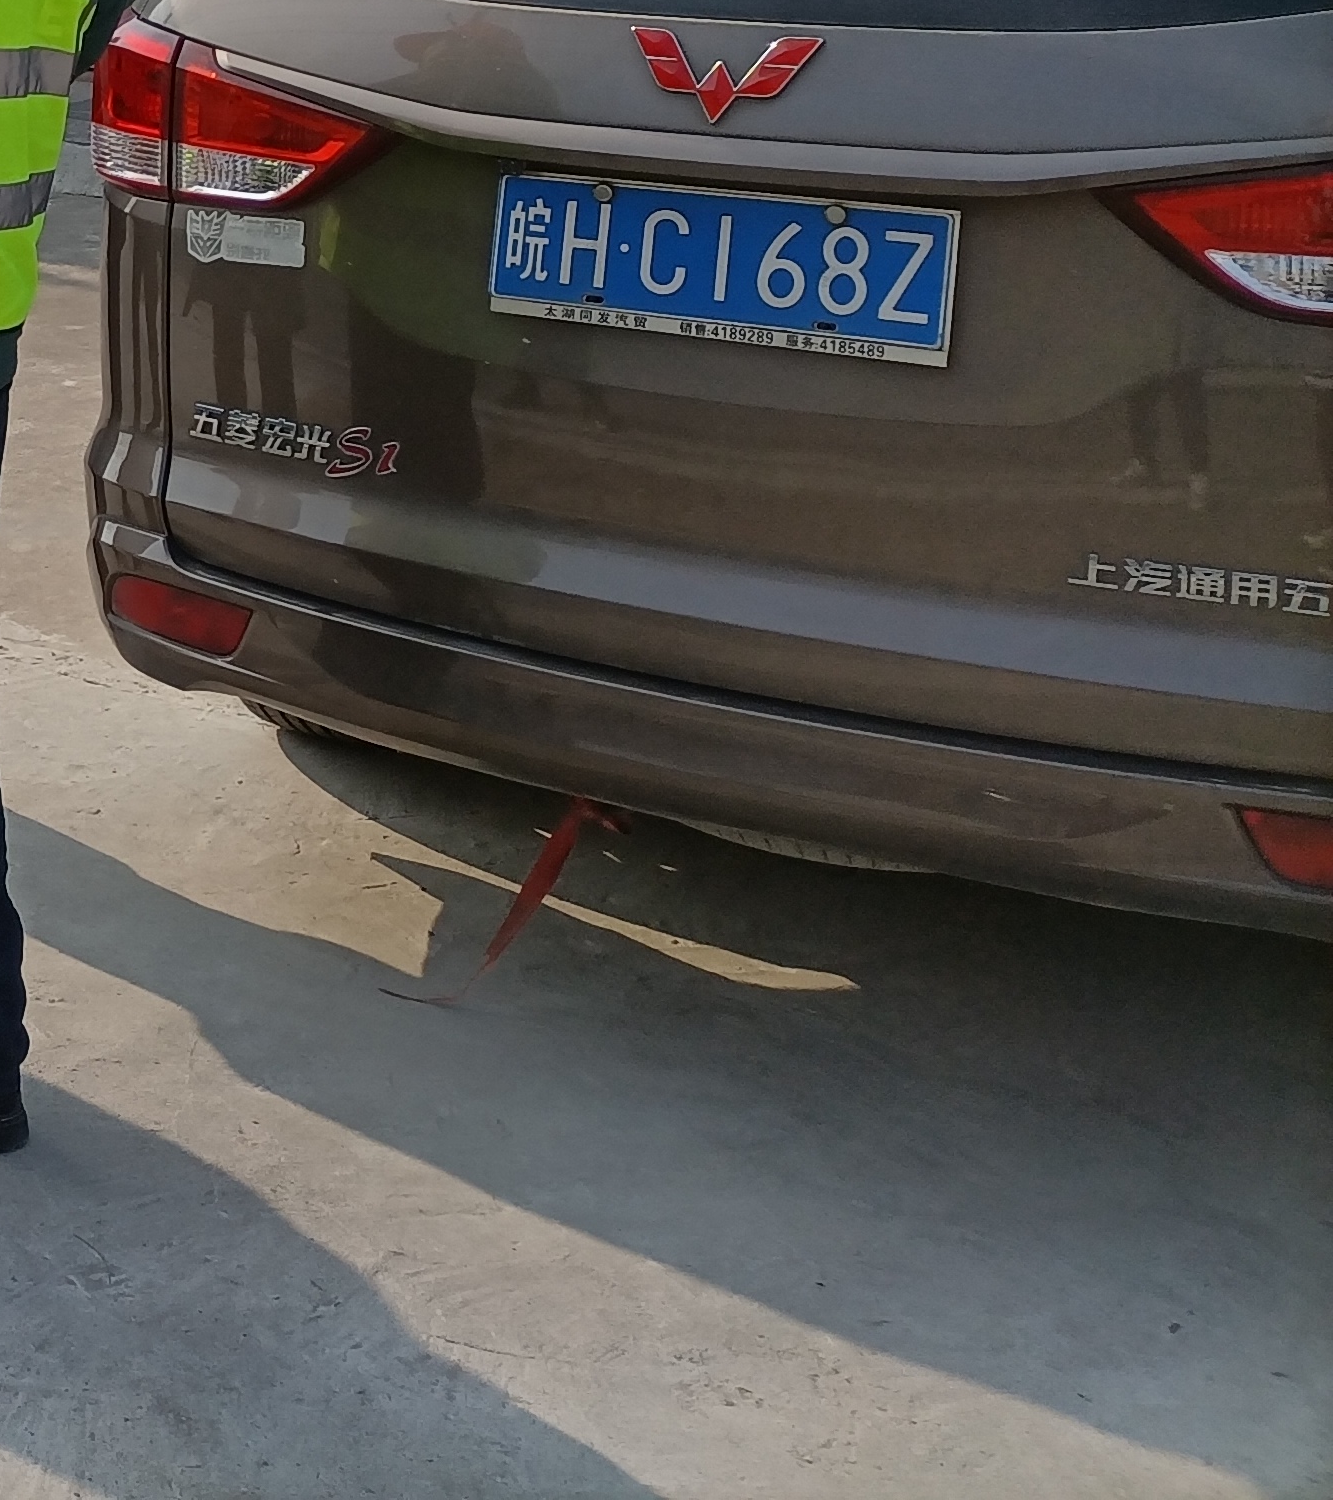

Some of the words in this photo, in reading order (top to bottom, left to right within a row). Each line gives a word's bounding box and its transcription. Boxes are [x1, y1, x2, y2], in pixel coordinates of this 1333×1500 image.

[189, 401, 331, 465] 五菱宏光
[1066, 553, 1333, 617] 上汽通用五
